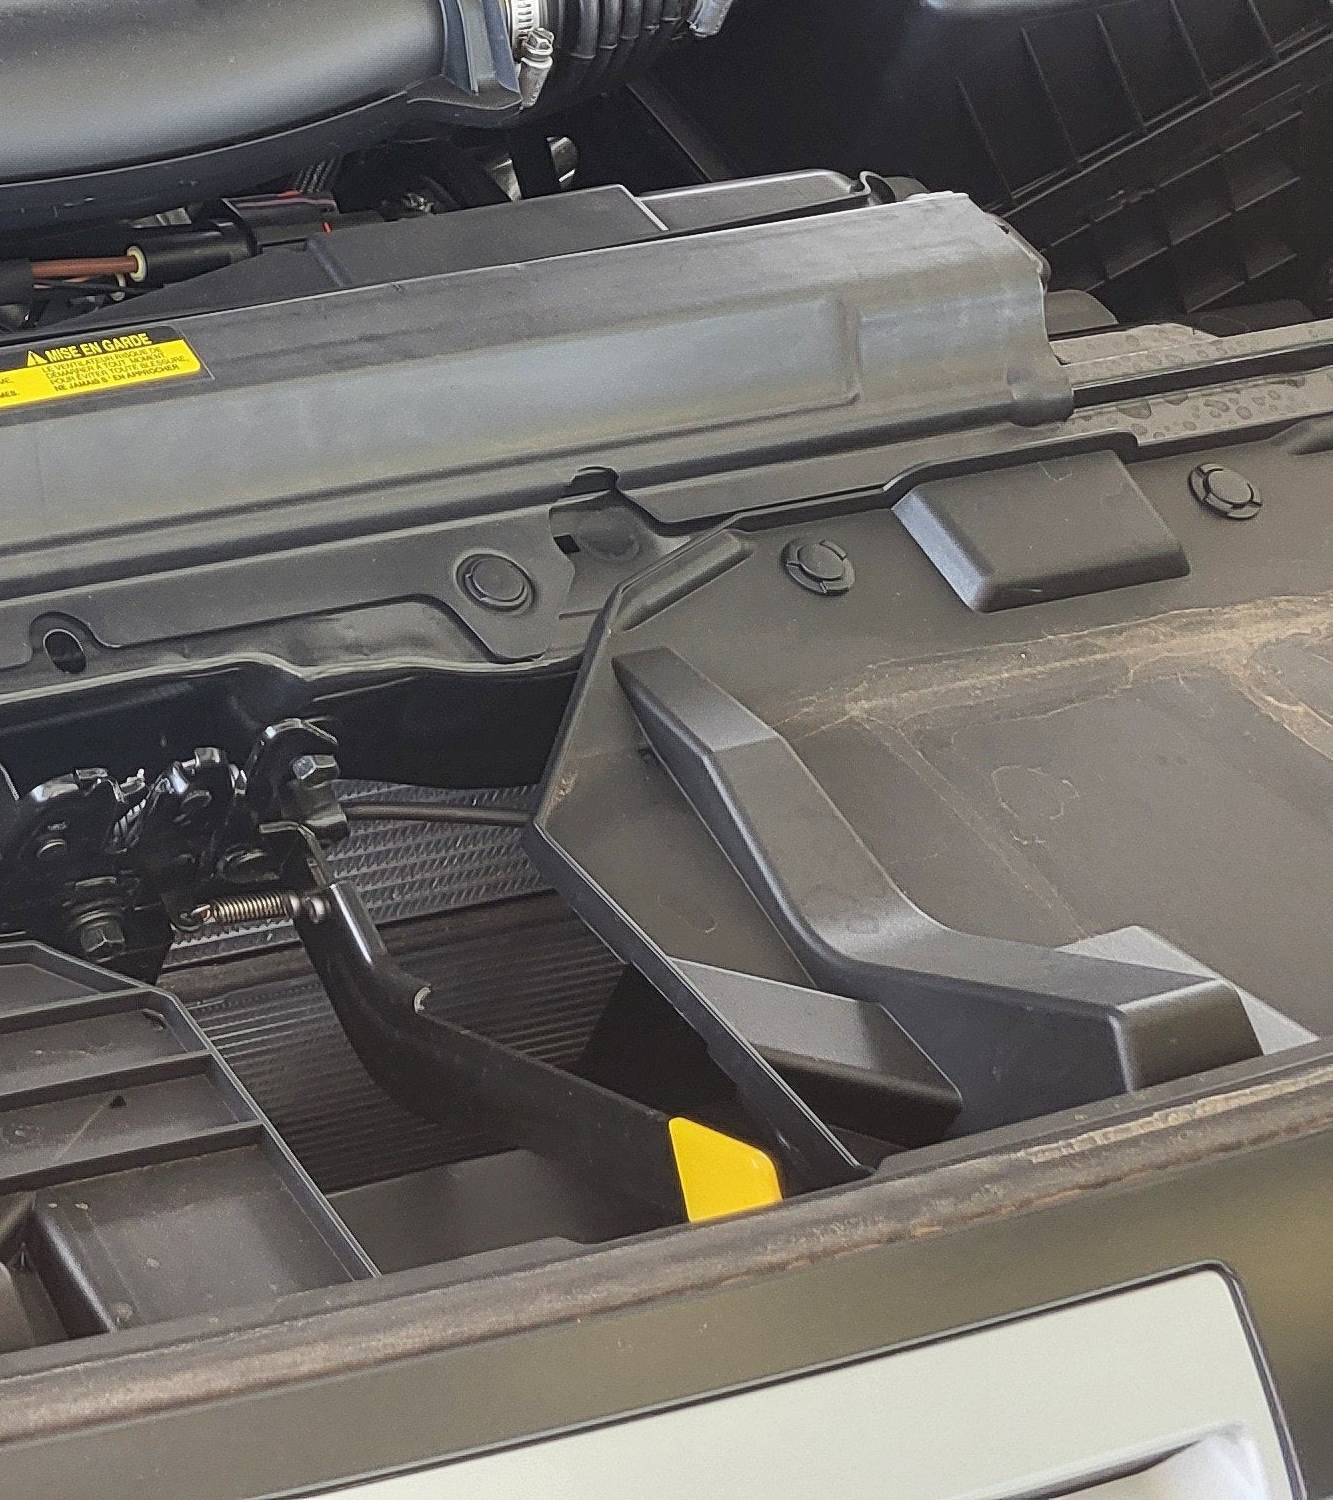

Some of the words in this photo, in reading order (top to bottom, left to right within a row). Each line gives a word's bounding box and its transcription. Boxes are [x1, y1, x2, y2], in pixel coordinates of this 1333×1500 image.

[44, 345, 79, 363] MISE
[79, 341, 102, 358] EN
[102, 332, 153, 352] GARDE
[54, 355, 113, 371] VENTILATEUR
[114, 349, 148, 361] RISQUE
[103, 360, 128, 370] TOUT
[129, 352, 166, 365] MOMENT
[49, 376, 76, 386] POUR
[108, 366, 137, 377] TOUTE
[54, 384, 68, 392] NE
[69, 377, 101, 390] JAMAIS
[125, 364, 180, 380] APPROCHER
